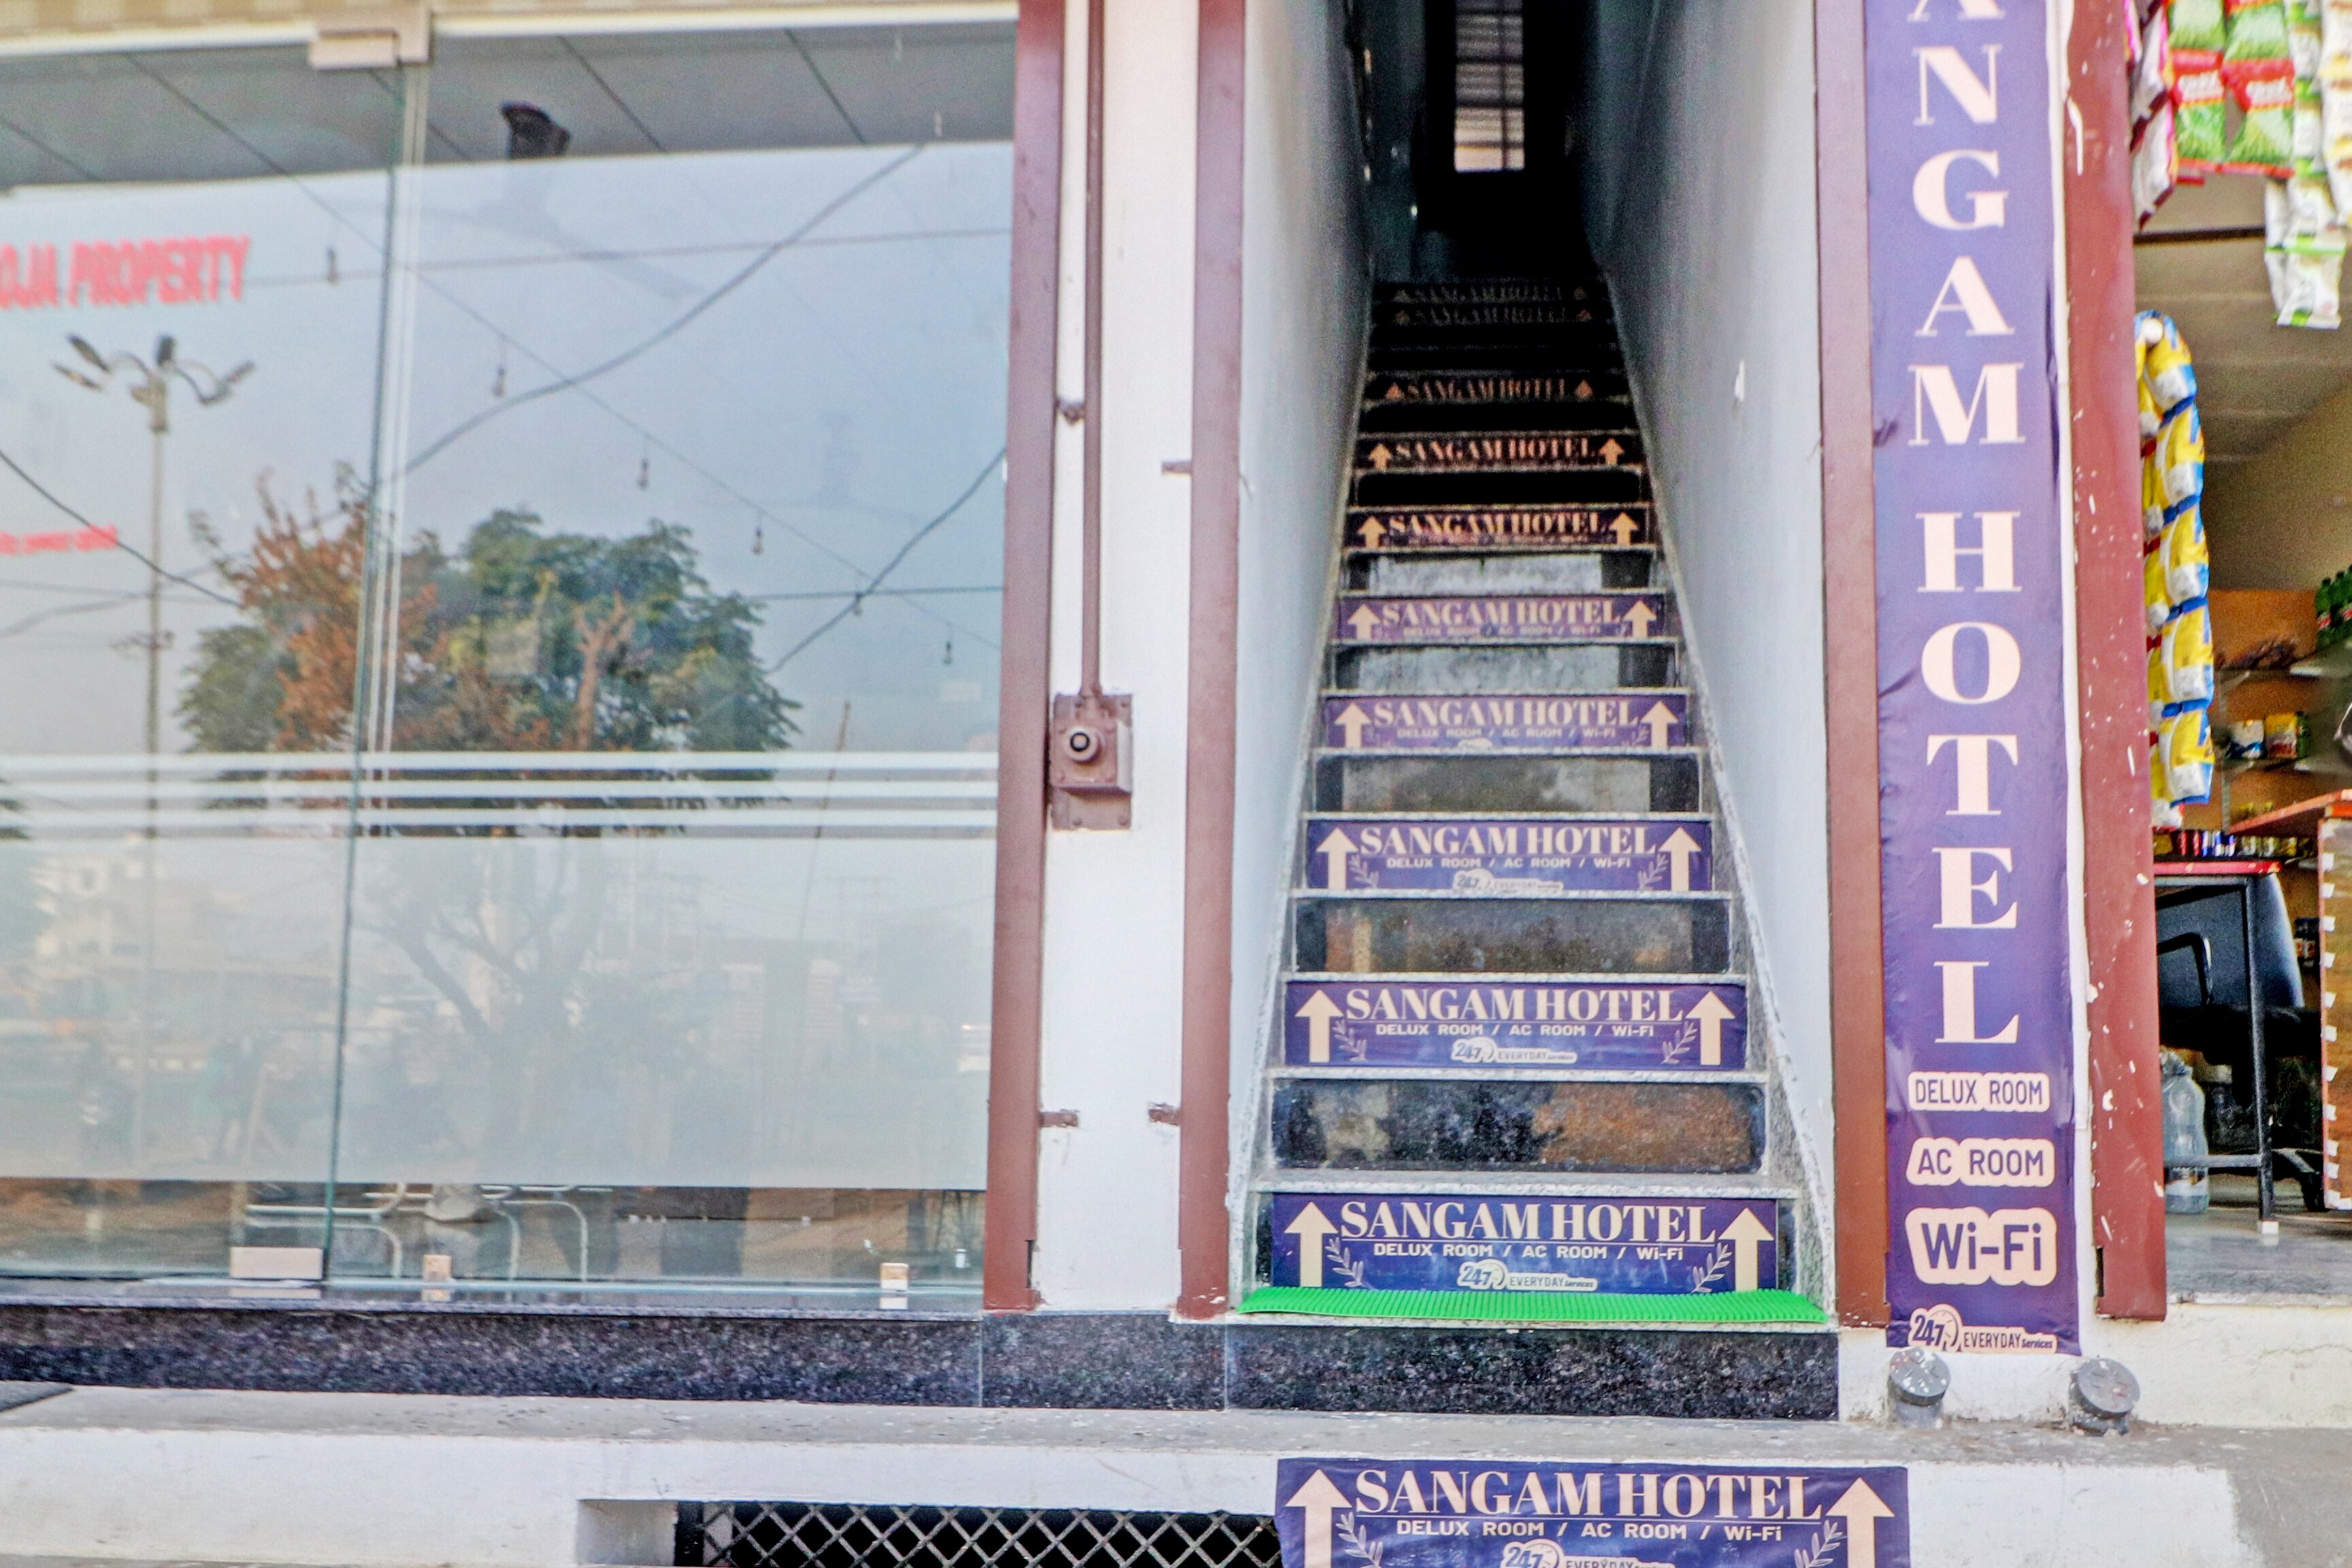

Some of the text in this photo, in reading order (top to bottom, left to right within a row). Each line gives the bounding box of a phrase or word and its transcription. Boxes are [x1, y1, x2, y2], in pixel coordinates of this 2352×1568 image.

[69, 233, 250, 306] PROPERTY
[1388, 512, 1605, 534] SANGAM HOTEL
[1908, 0, 2026, 1043] NGAM HOTEL
[1382, 600, 1620, 625] SANGAM HOTEL
[1374, 700, 1639, 726] SANGAM HOTEL
[1360, 826, 1656, 855] SANGAM HOTEL
[1386, 858, 1631, 868] DELUX ROOM / AC ROOM / Wi-Fi
[1346, 988, 1684, 1022] SANGAM HOTEL
[1376, 1024, 1654, 1036] DELUX ROOM / AC ROOM / Wi-Fi
[1455, 1043, 1482, 1059] 247
[1498, 1051, 1548, 1060] EVERYDAY
[1916, 1079, 2042, 1105] DELUX ROOM
[1918, 1149, 2044, 1176] AC ROOM
[1341, 1201, 1716, 1243] SANGAM HOTEL
[1373, 1243, 1684, 1260] DELUX ROOM / AC ROOM / Wi-Fi
[1921, 1222, 2042, 1271] Wi-Fi
[1463, 1266, 1492, 1285] 247
[1510, 1276, 1564, 1287] EVERYDAY
[1912, 1315, 1944, 1346] 247
[1963, 1332, 2021, 1348] EVERYDAY
[1356, 1469, 1822, 1520] SANGAM HOTEL
[1396, 1520, 1782, 1541] DELUX ROOM / AC ROOM / Wi-Fi
